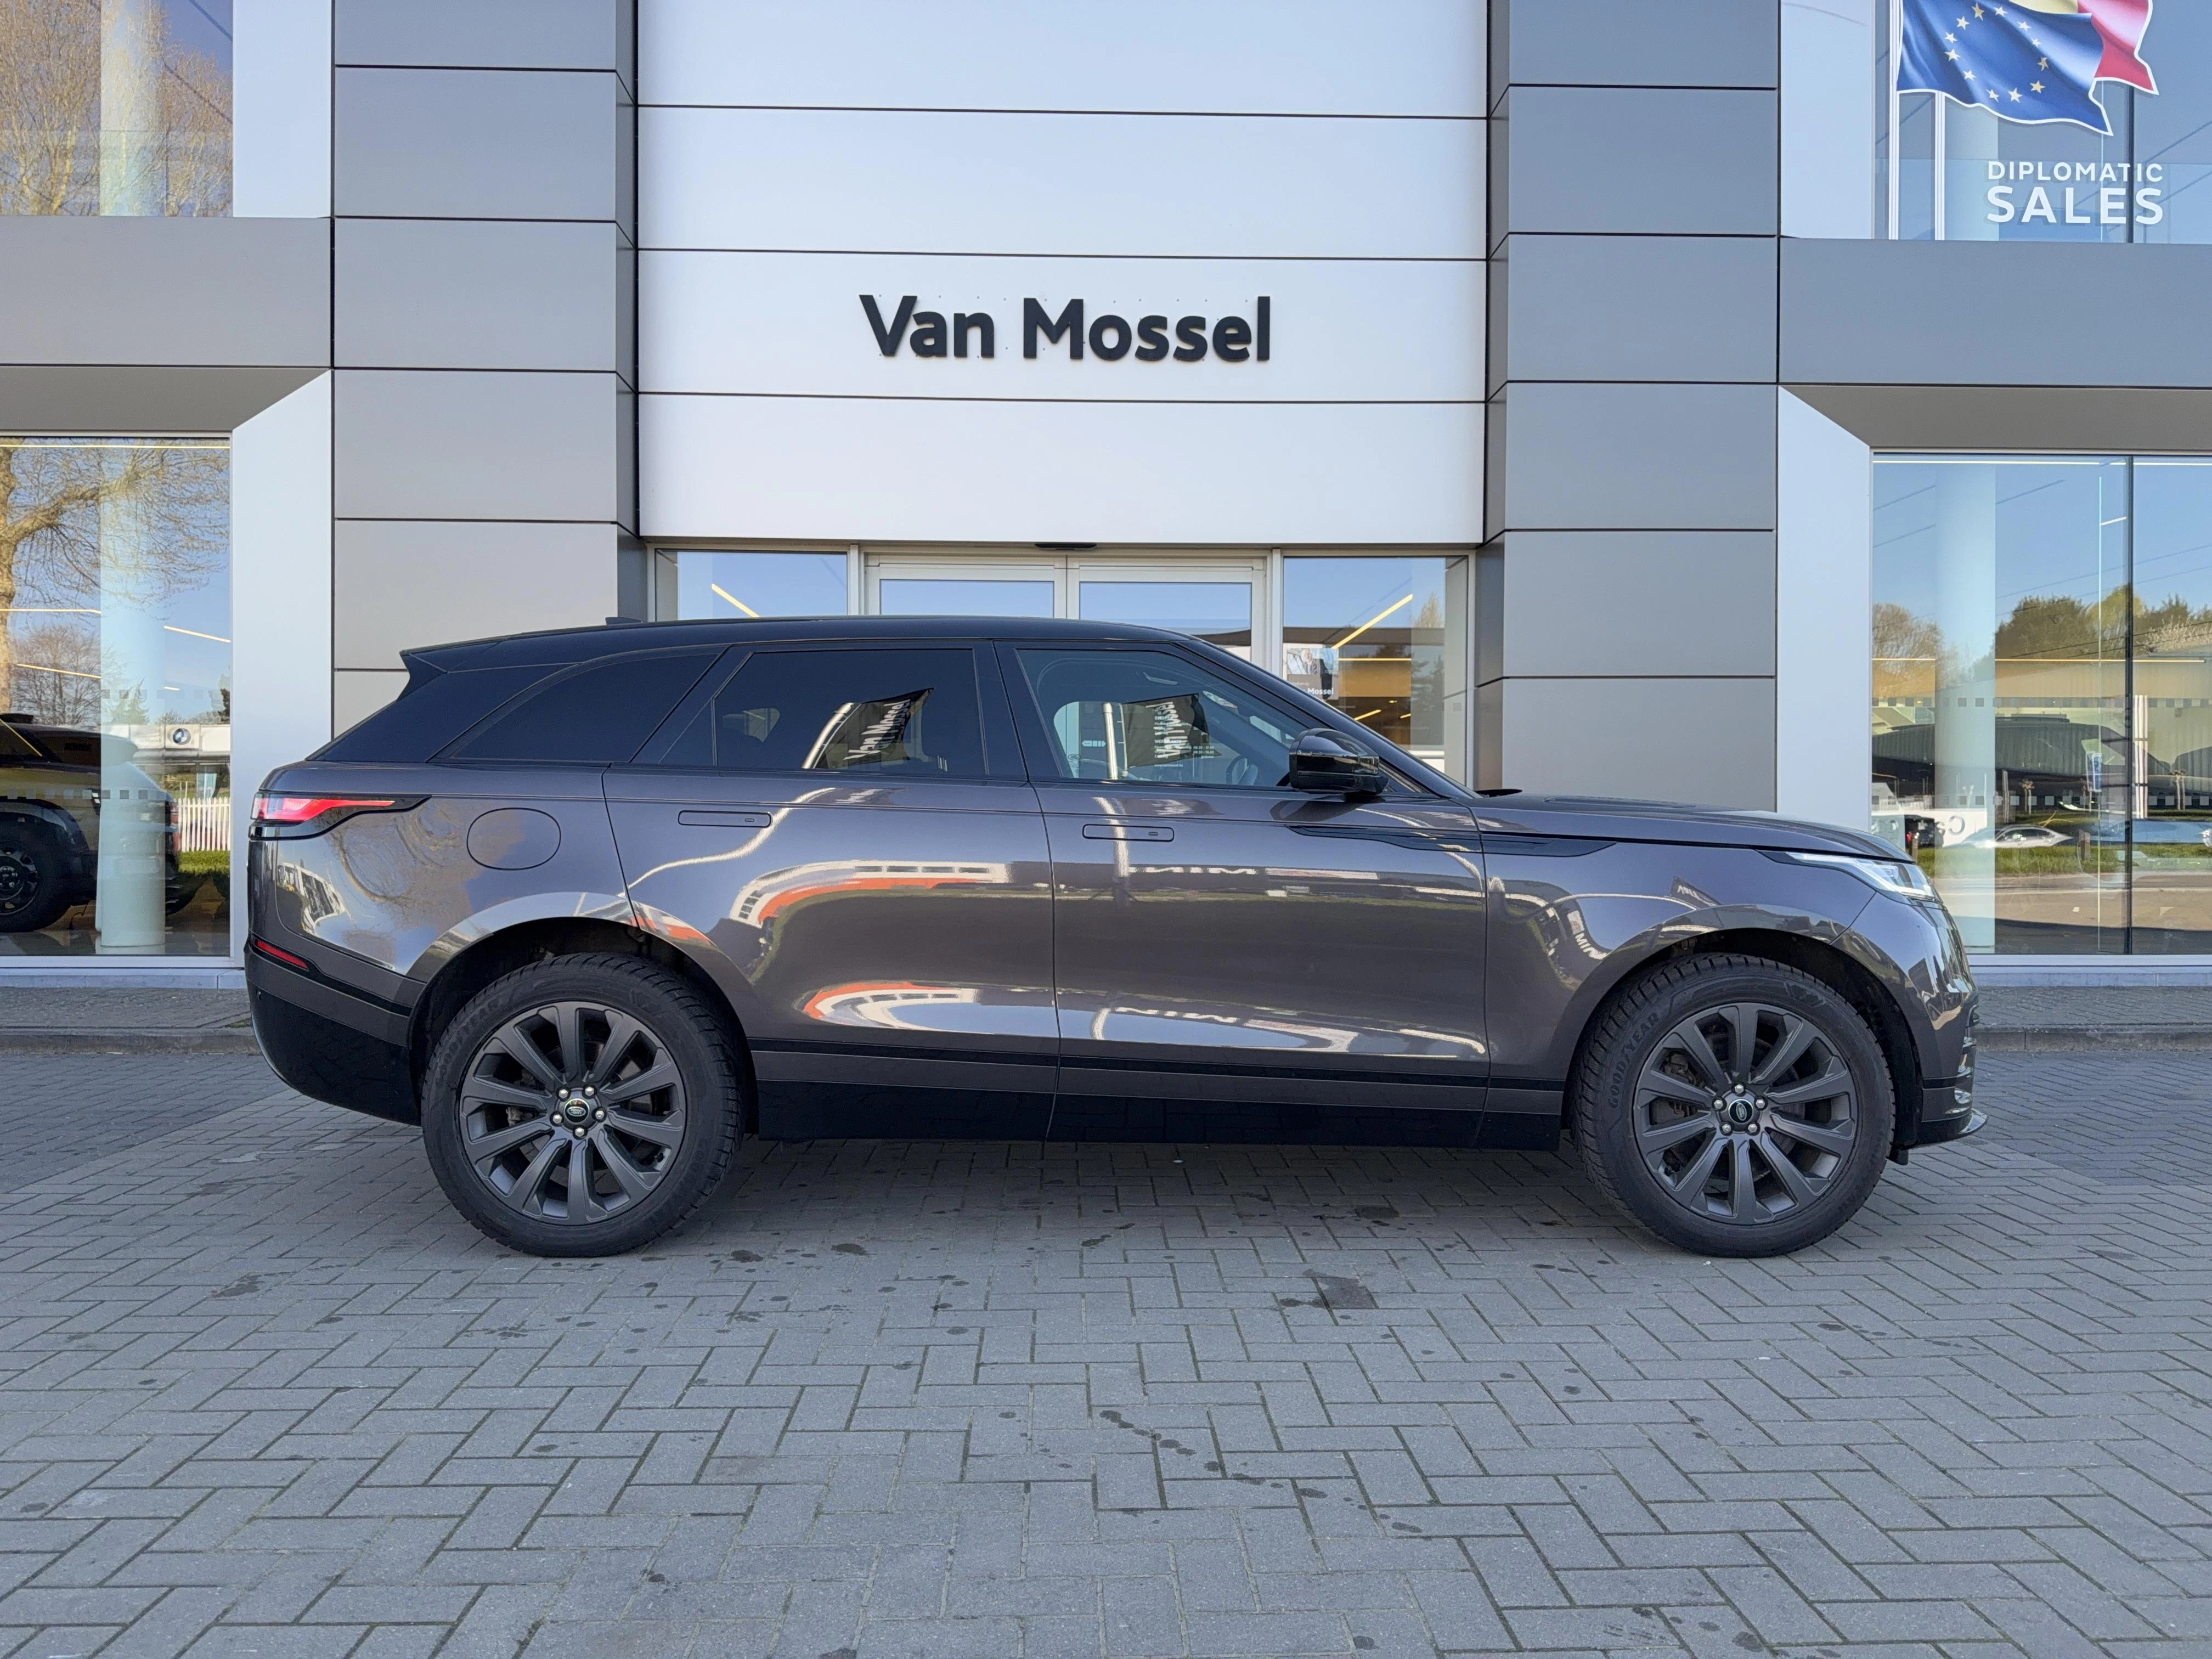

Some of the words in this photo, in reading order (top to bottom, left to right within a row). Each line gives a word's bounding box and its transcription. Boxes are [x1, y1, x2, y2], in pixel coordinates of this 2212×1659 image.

[1988, 161, 2163, 182] DIPLOMATIC
[1987, 185, 2163, 224] SALES
[859, 295, 994, 358] Van
[1023, 296, 1271, 361] Mossel
[843, 736, 895, 760] Van
